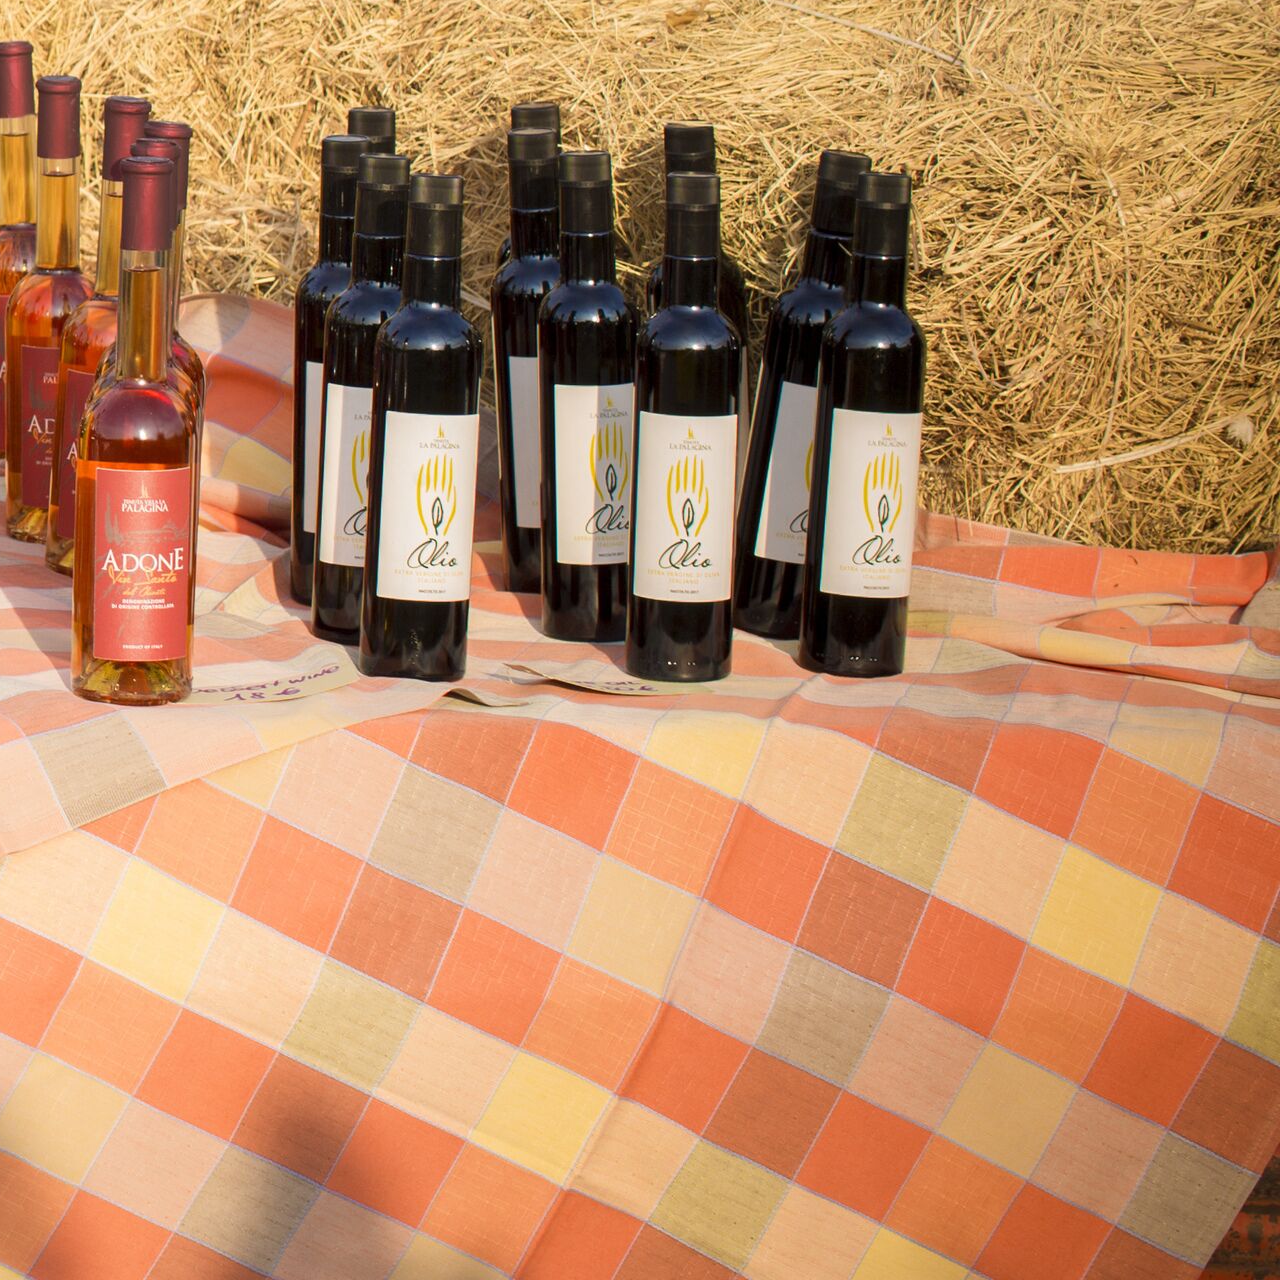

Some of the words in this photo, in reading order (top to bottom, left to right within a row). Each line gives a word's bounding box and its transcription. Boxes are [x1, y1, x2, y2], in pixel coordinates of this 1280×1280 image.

[121, 504, 169, 513] PALAGINA
[101, 547, 184, 573] ADONE
[406, 537, 458, 569] Olio
[658, 538, 713, 570] Olio
[851, 534, 902, 566] Olio
[107, 564, 132, 585] Vin
[133, 566, 177, 586] Santo
